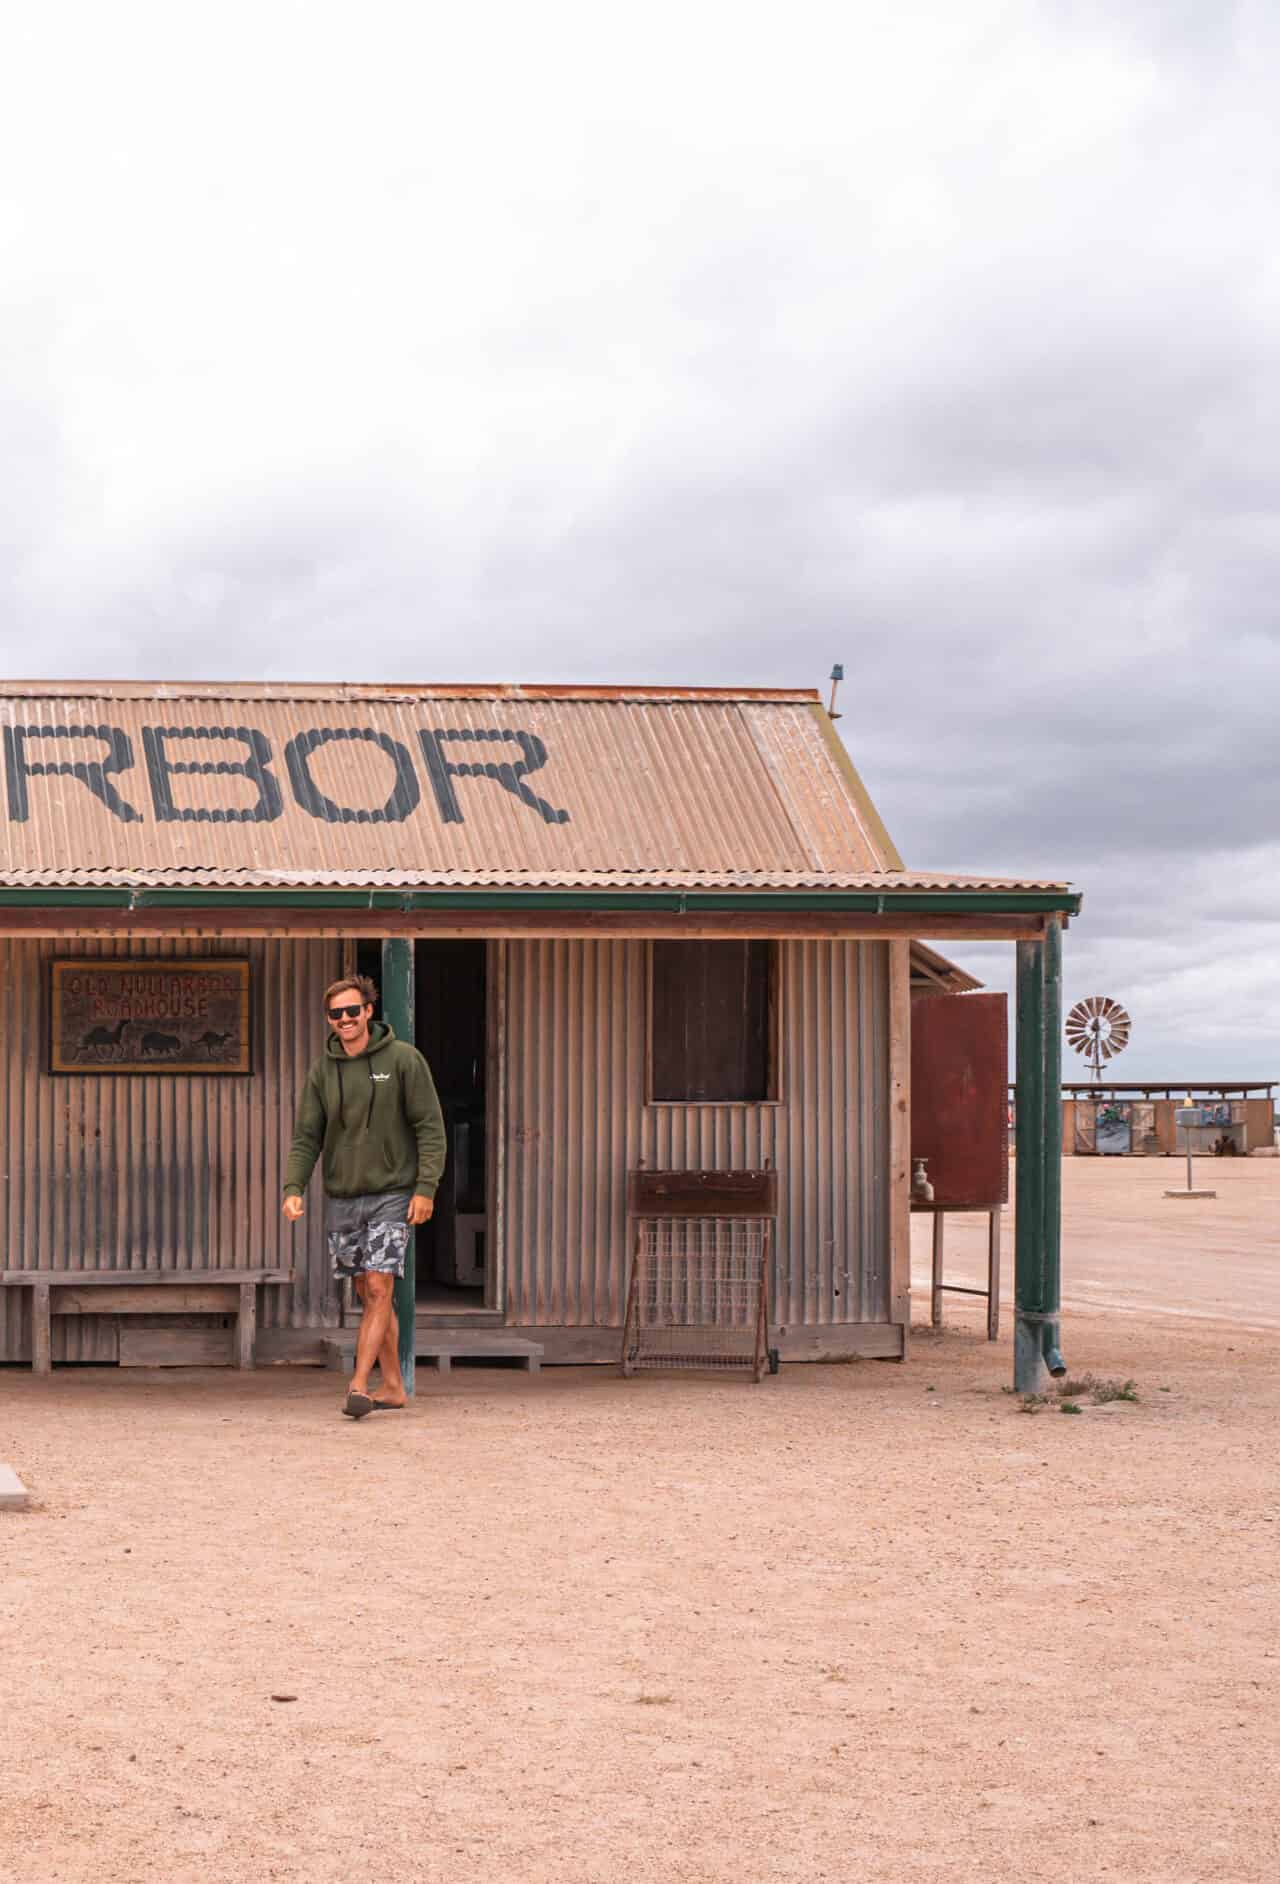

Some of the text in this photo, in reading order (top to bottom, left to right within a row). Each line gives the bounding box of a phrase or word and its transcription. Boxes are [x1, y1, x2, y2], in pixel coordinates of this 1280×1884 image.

[69, 976, 235, 997] OLD NULLARBOR
[94, 998, 209, 1017] ROADHOUSE
